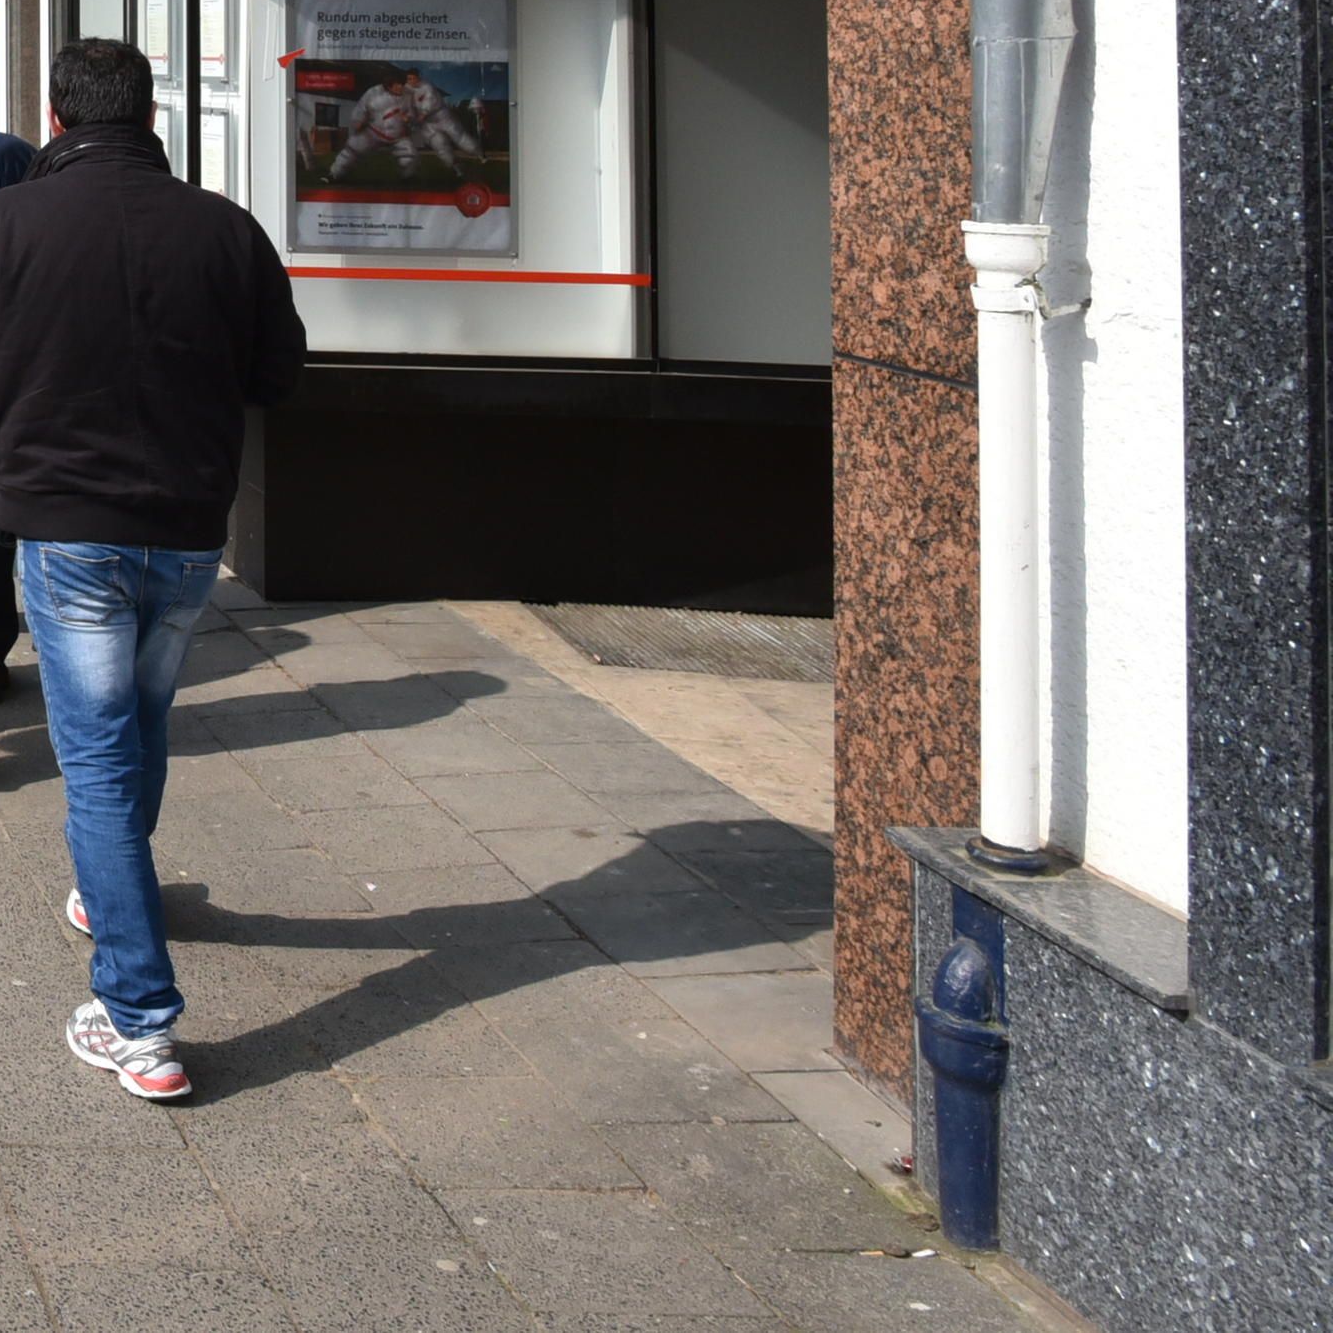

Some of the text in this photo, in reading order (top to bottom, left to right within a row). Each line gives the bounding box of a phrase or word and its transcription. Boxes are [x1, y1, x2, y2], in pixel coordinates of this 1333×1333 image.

[317, 11, 449, 27] Rundum abgesichert
[317, 28, 471, 42] gegen steigende Zinsen.
